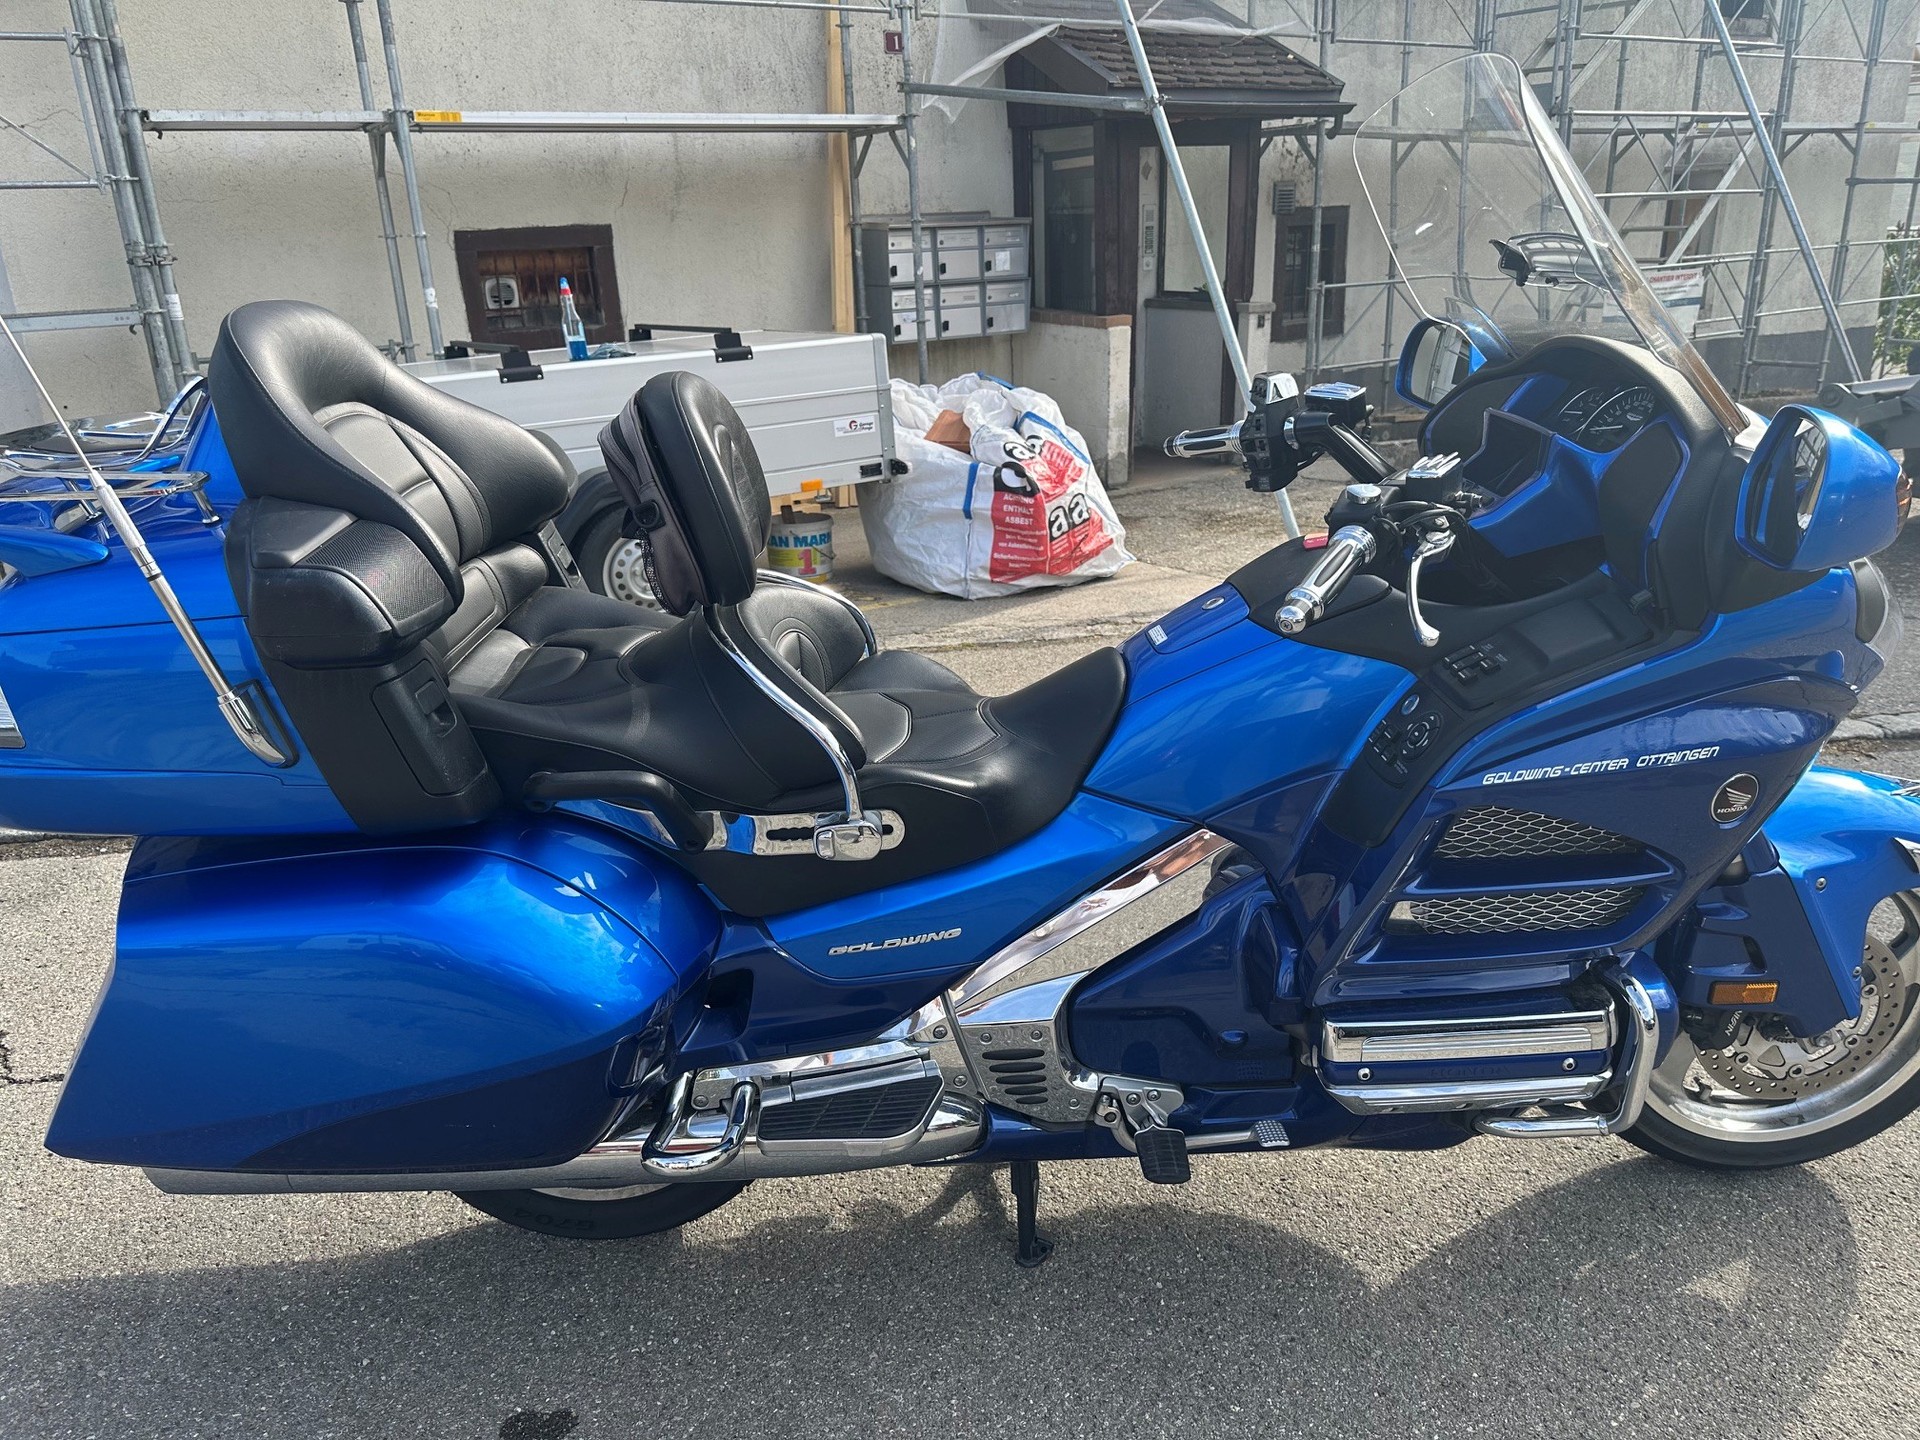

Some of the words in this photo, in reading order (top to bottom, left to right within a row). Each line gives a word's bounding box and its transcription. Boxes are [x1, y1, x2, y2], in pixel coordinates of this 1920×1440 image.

[893, 35, 899, 50] 1
[1004, 516, 1034, 526] ASBEST
[769, 535, 790, 548] AN
[798, 548, 817, 575] 1
[1482, 759, 1630, 785] GOLDWING-CENTER
[1636, 746, 1720, 767] OFTRINGEN
[1717, 805, 1748, 814] HONDA
[828, 927, 963, 956] GOLDWING
